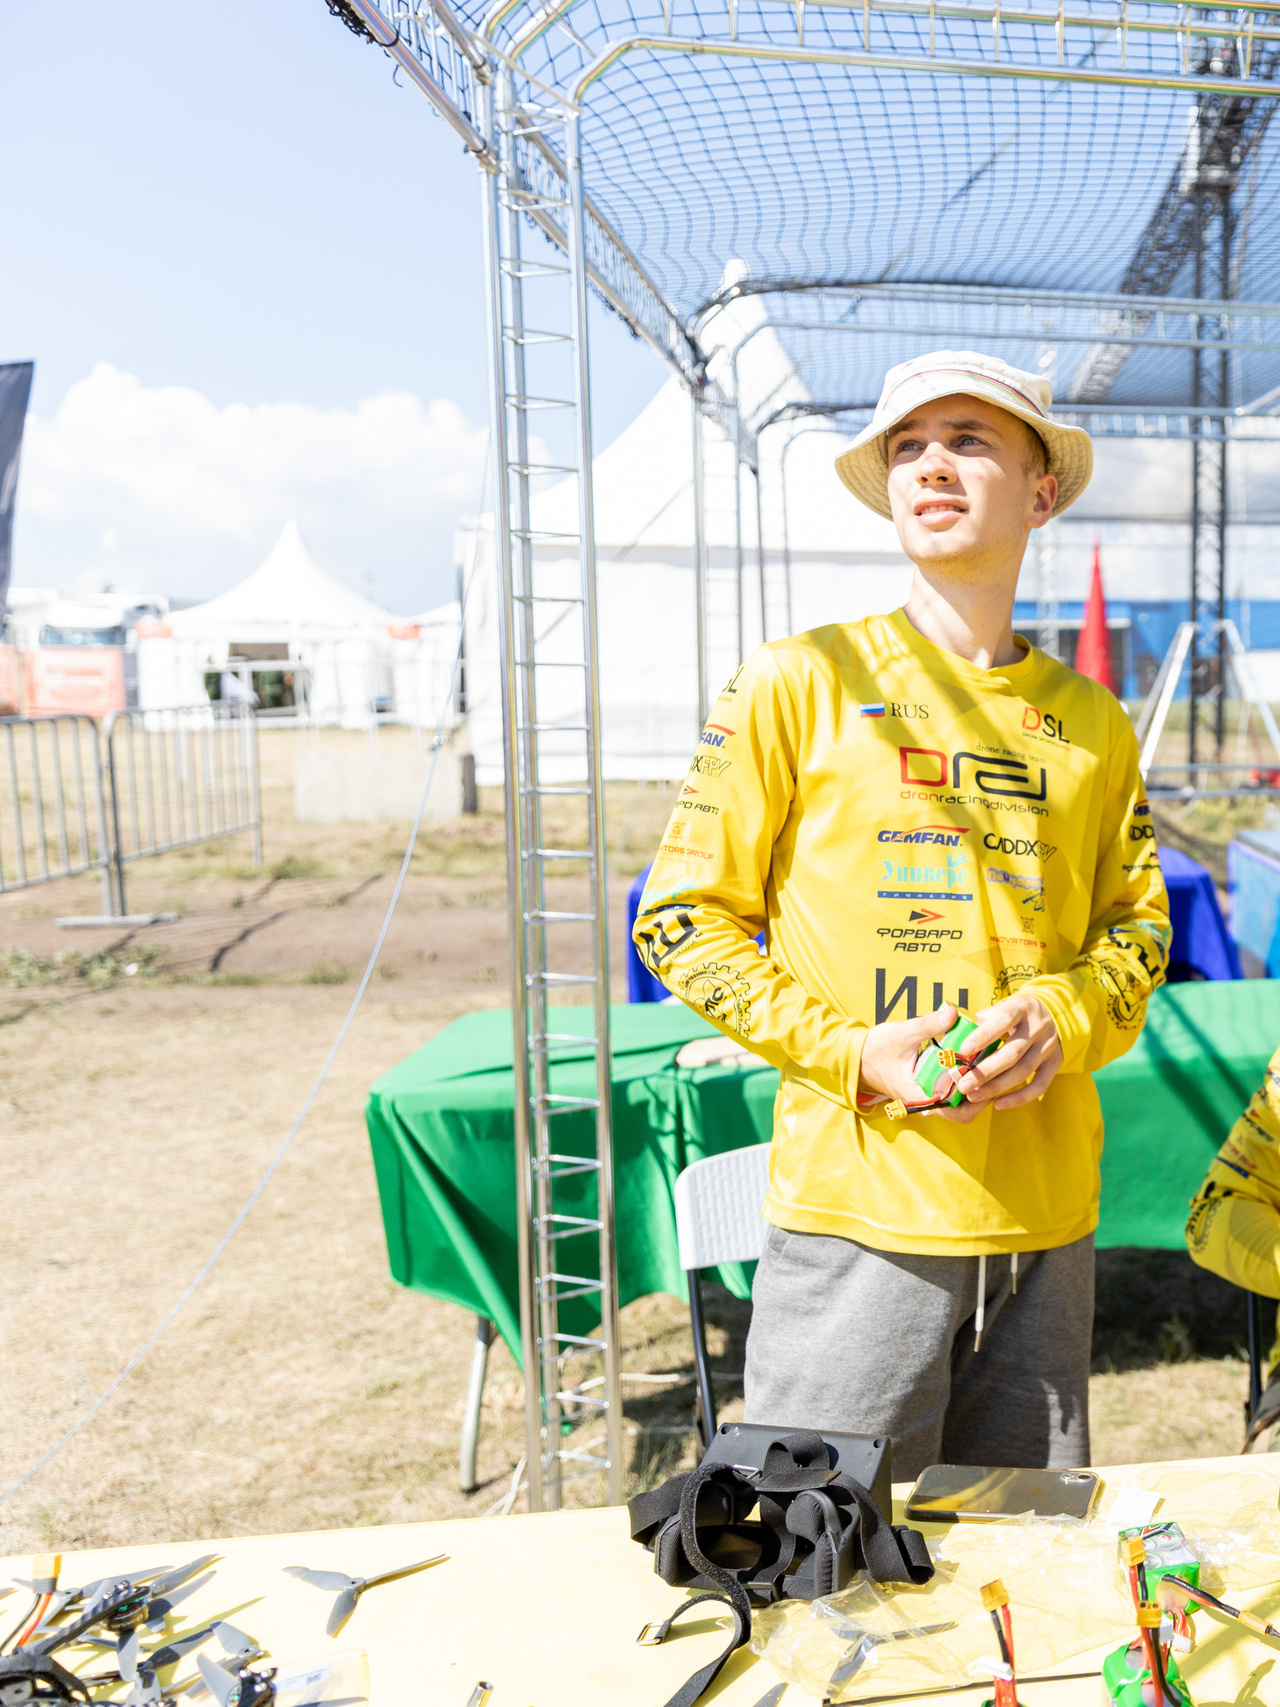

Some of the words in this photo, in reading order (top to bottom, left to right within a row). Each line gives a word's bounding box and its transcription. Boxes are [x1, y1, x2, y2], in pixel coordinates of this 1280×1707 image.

[890, 702, 930, 720] RUS
[1022, 706, 1070, 744] DSL
[976, 742, 1000, 753] drone
[1002, 749, 1027, 762] racing
[900, 790, 1049, 817] dronracingdivision
[877, 828, 962, 848] GEMFAN
